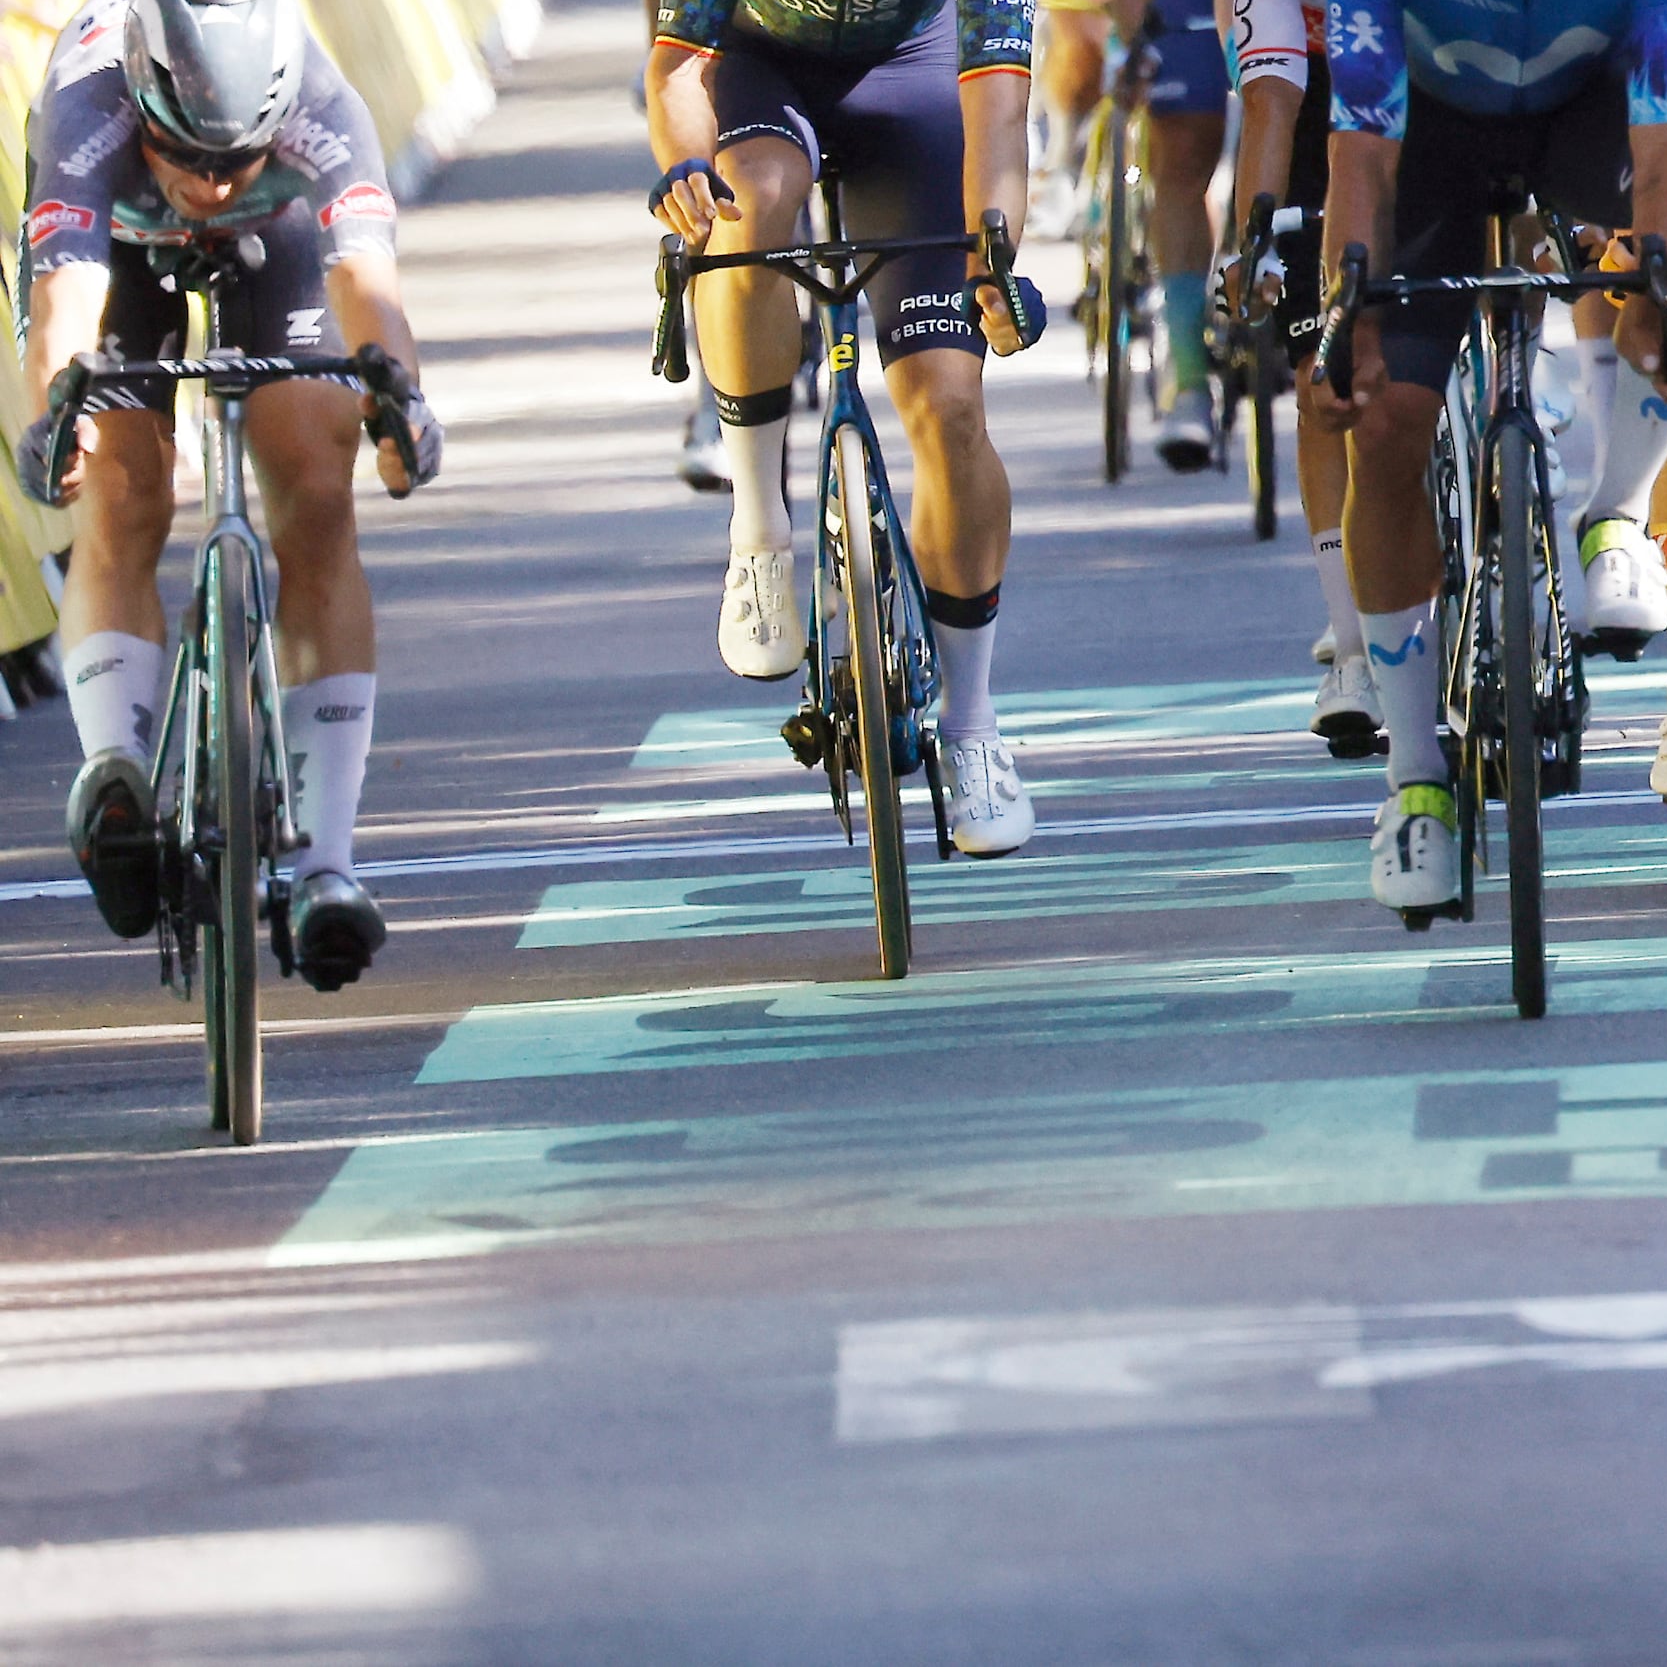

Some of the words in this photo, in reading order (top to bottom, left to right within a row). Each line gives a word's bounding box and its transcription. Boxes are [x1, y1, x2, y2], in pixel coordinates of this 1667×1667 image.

[1328, 2, 1344, 59] vivo
[899, 291, 950, 313] AGU
[902, 318, 973, 339] BETCITY
